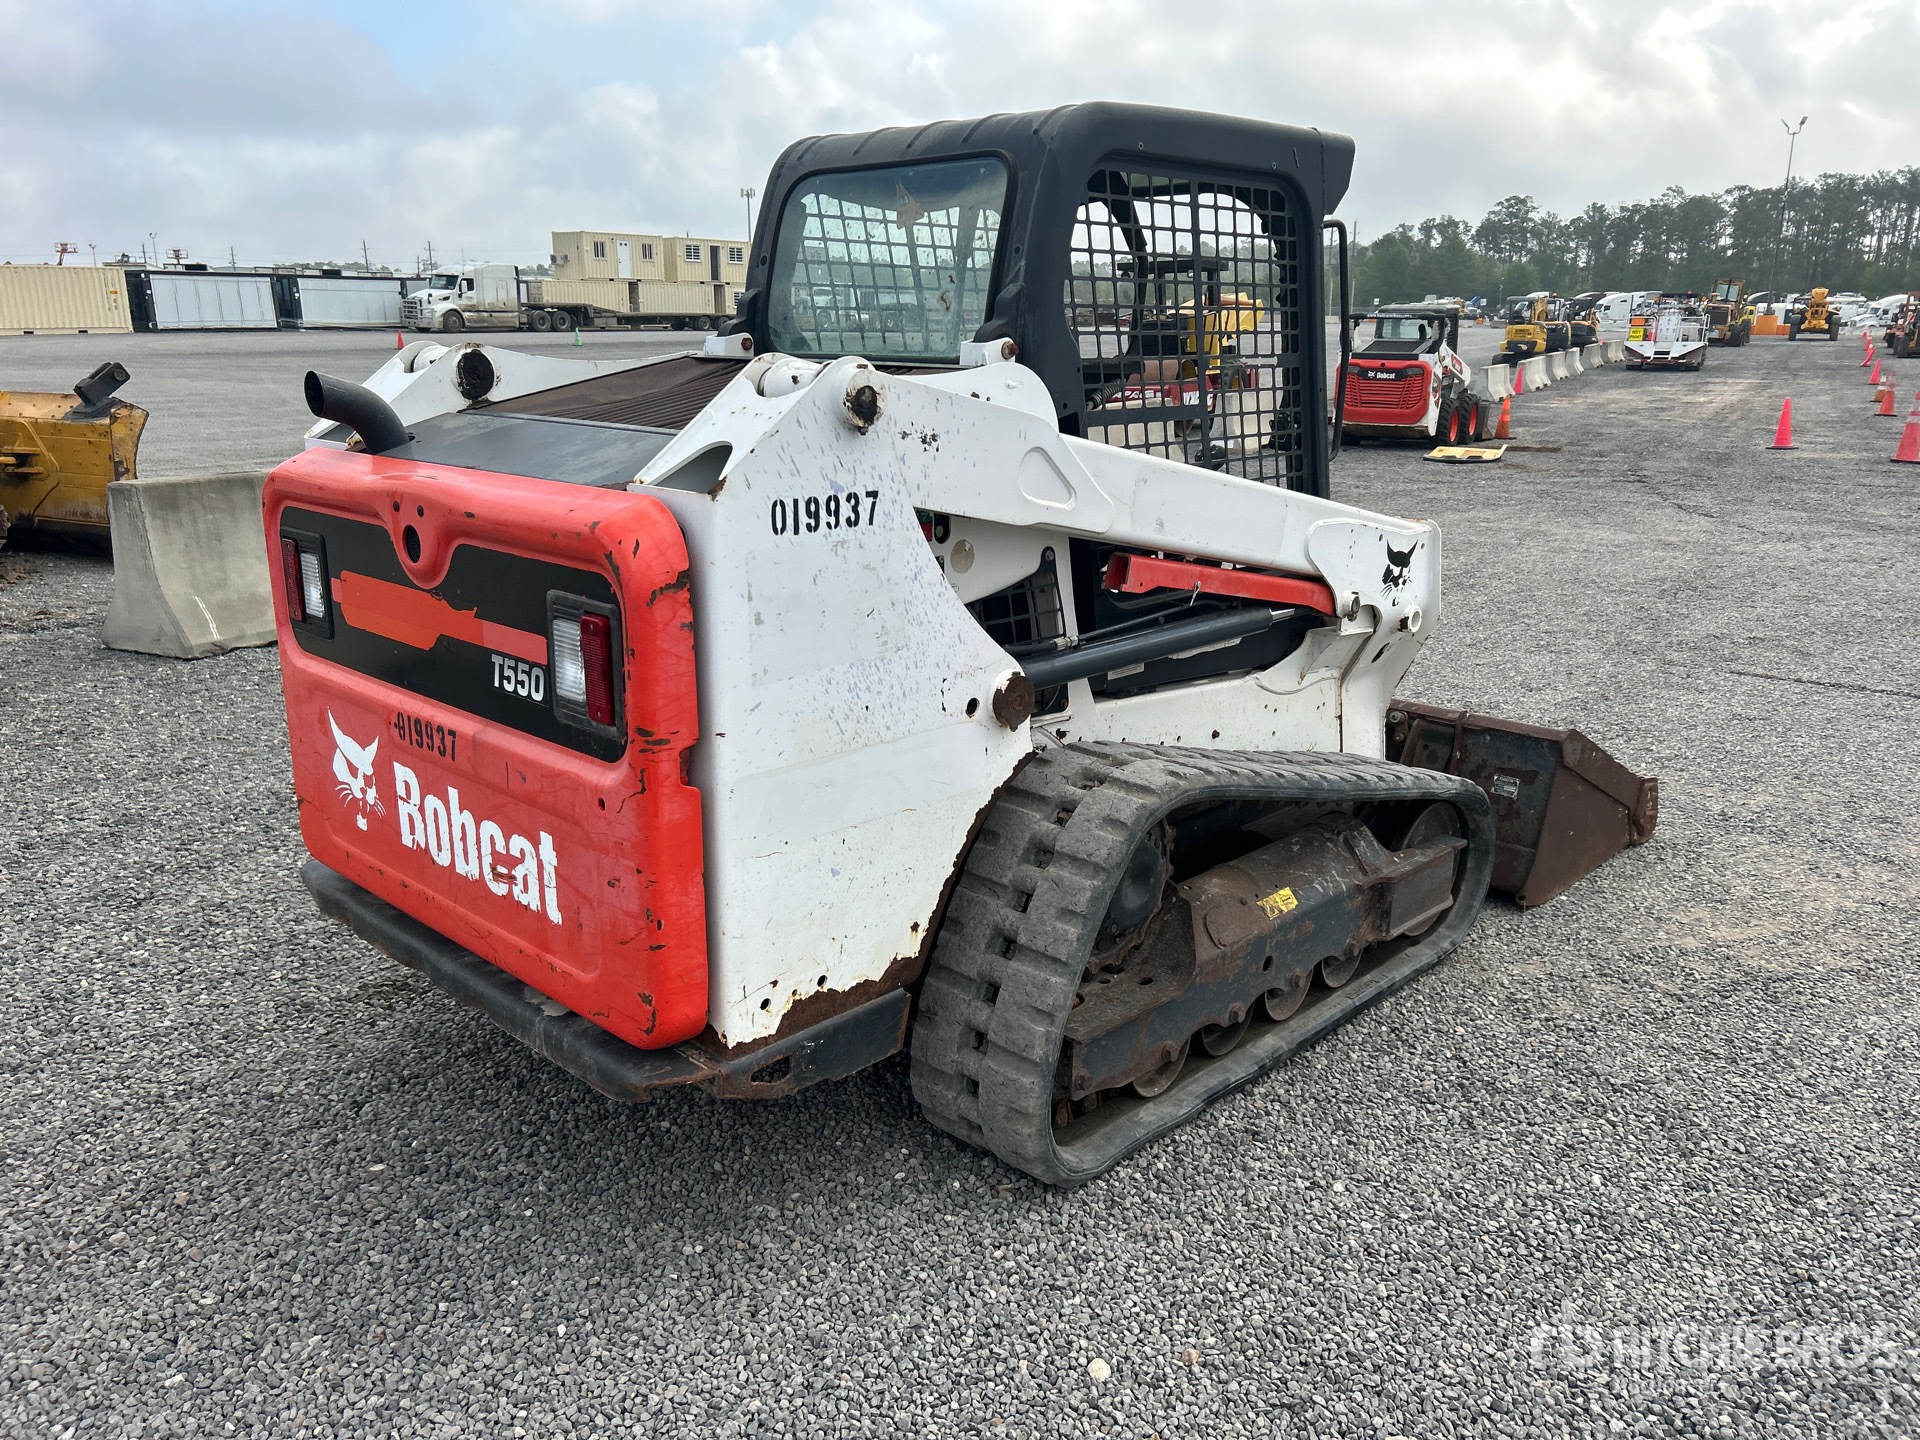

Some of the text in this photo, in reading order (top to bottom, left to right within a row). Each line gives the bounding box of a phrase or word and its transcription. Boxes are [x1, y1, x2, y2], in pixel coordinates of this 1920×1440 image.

[1376, 371, 1396, 379] Bobcat
[770, 490, 879, 536] 019937
[491, 653, 545, 701] T550
[396, 707, 456, 762] 019937
[393, 760, 564, 926] Bobcat
